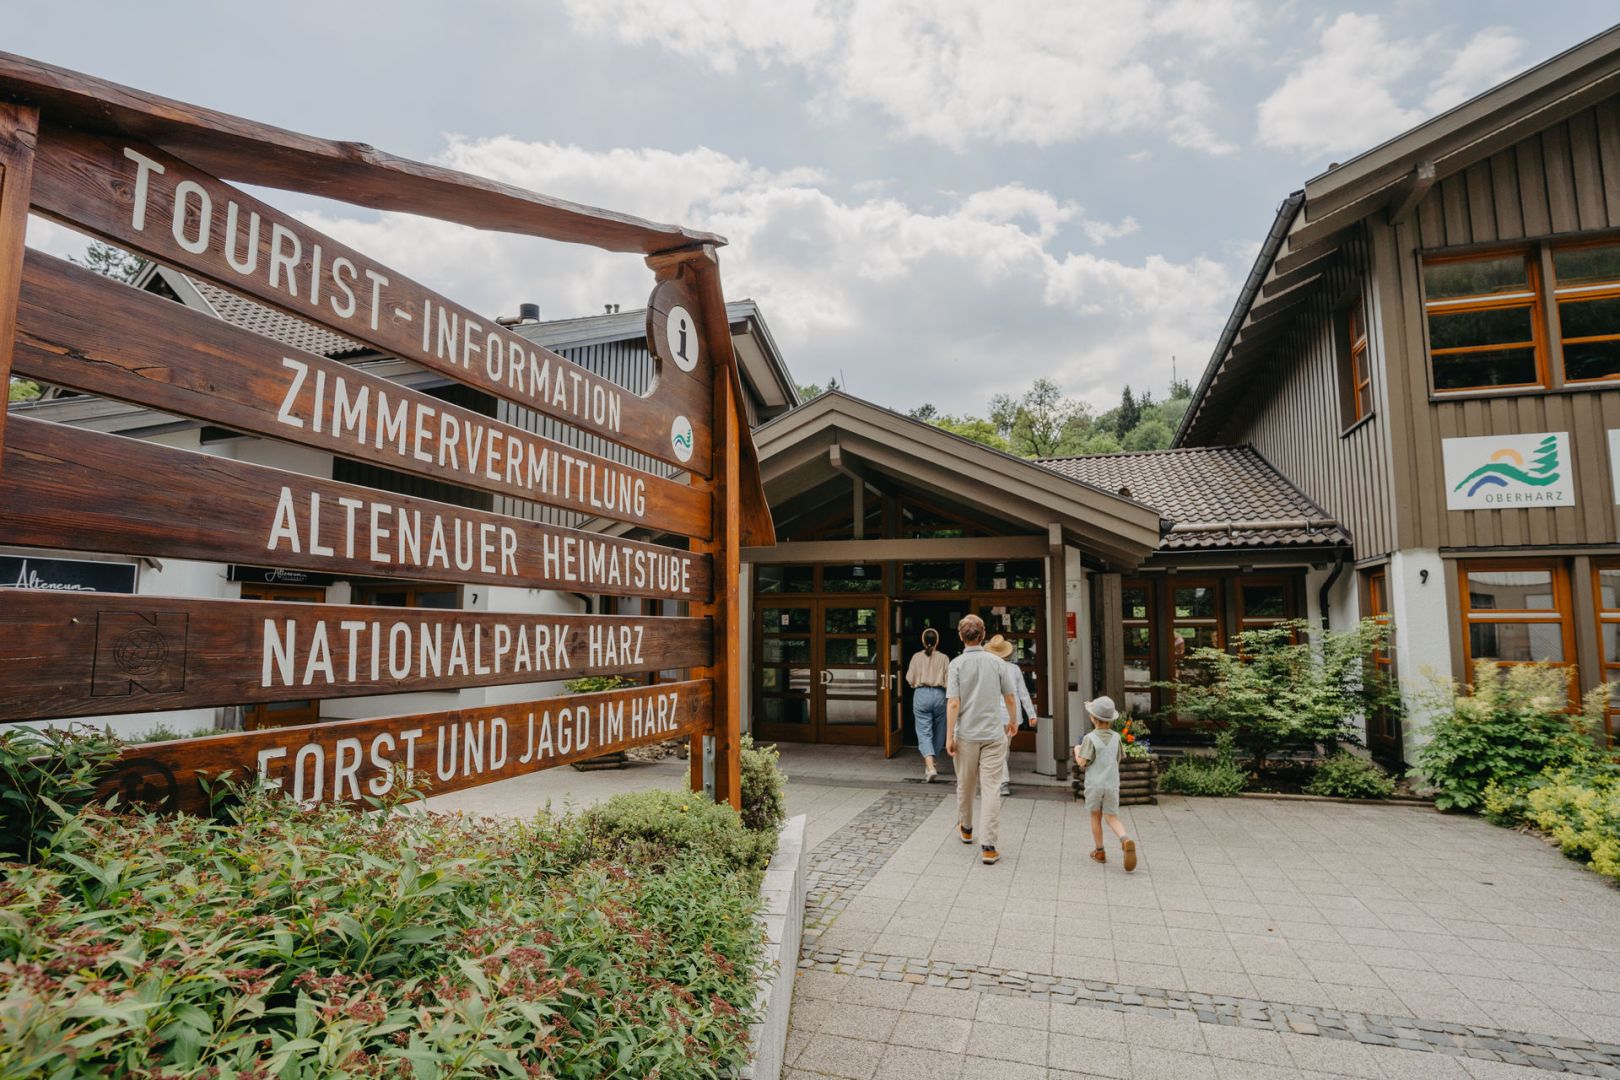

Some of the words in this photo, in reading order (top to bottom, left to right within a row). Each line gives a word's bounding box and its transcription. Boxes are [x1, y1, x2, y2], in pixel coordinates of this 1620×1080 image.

[277, 357, 645, 517] ZIMMERVERMITTLUNG
[1485, 491, 1563, 503] OBERHARZ
[267, 486, 518, 576] ALTENAUER
[544, 534, 691, 594] HEIMATSTUBE
[472, 593, 478, 604] 7
[1419, 569, 1429, 584] 9
[262, 618, 570, 687] NATIONALPARK
[589, 625, 644, 668] HARZ
[258, 729, 422, 810] FORST
[437, 717, 507, 781] UND
[520, 705, 590, 764] JAGD
[600, 700, 624, 746] IM
[632, 692, 678, 738] HARZ
